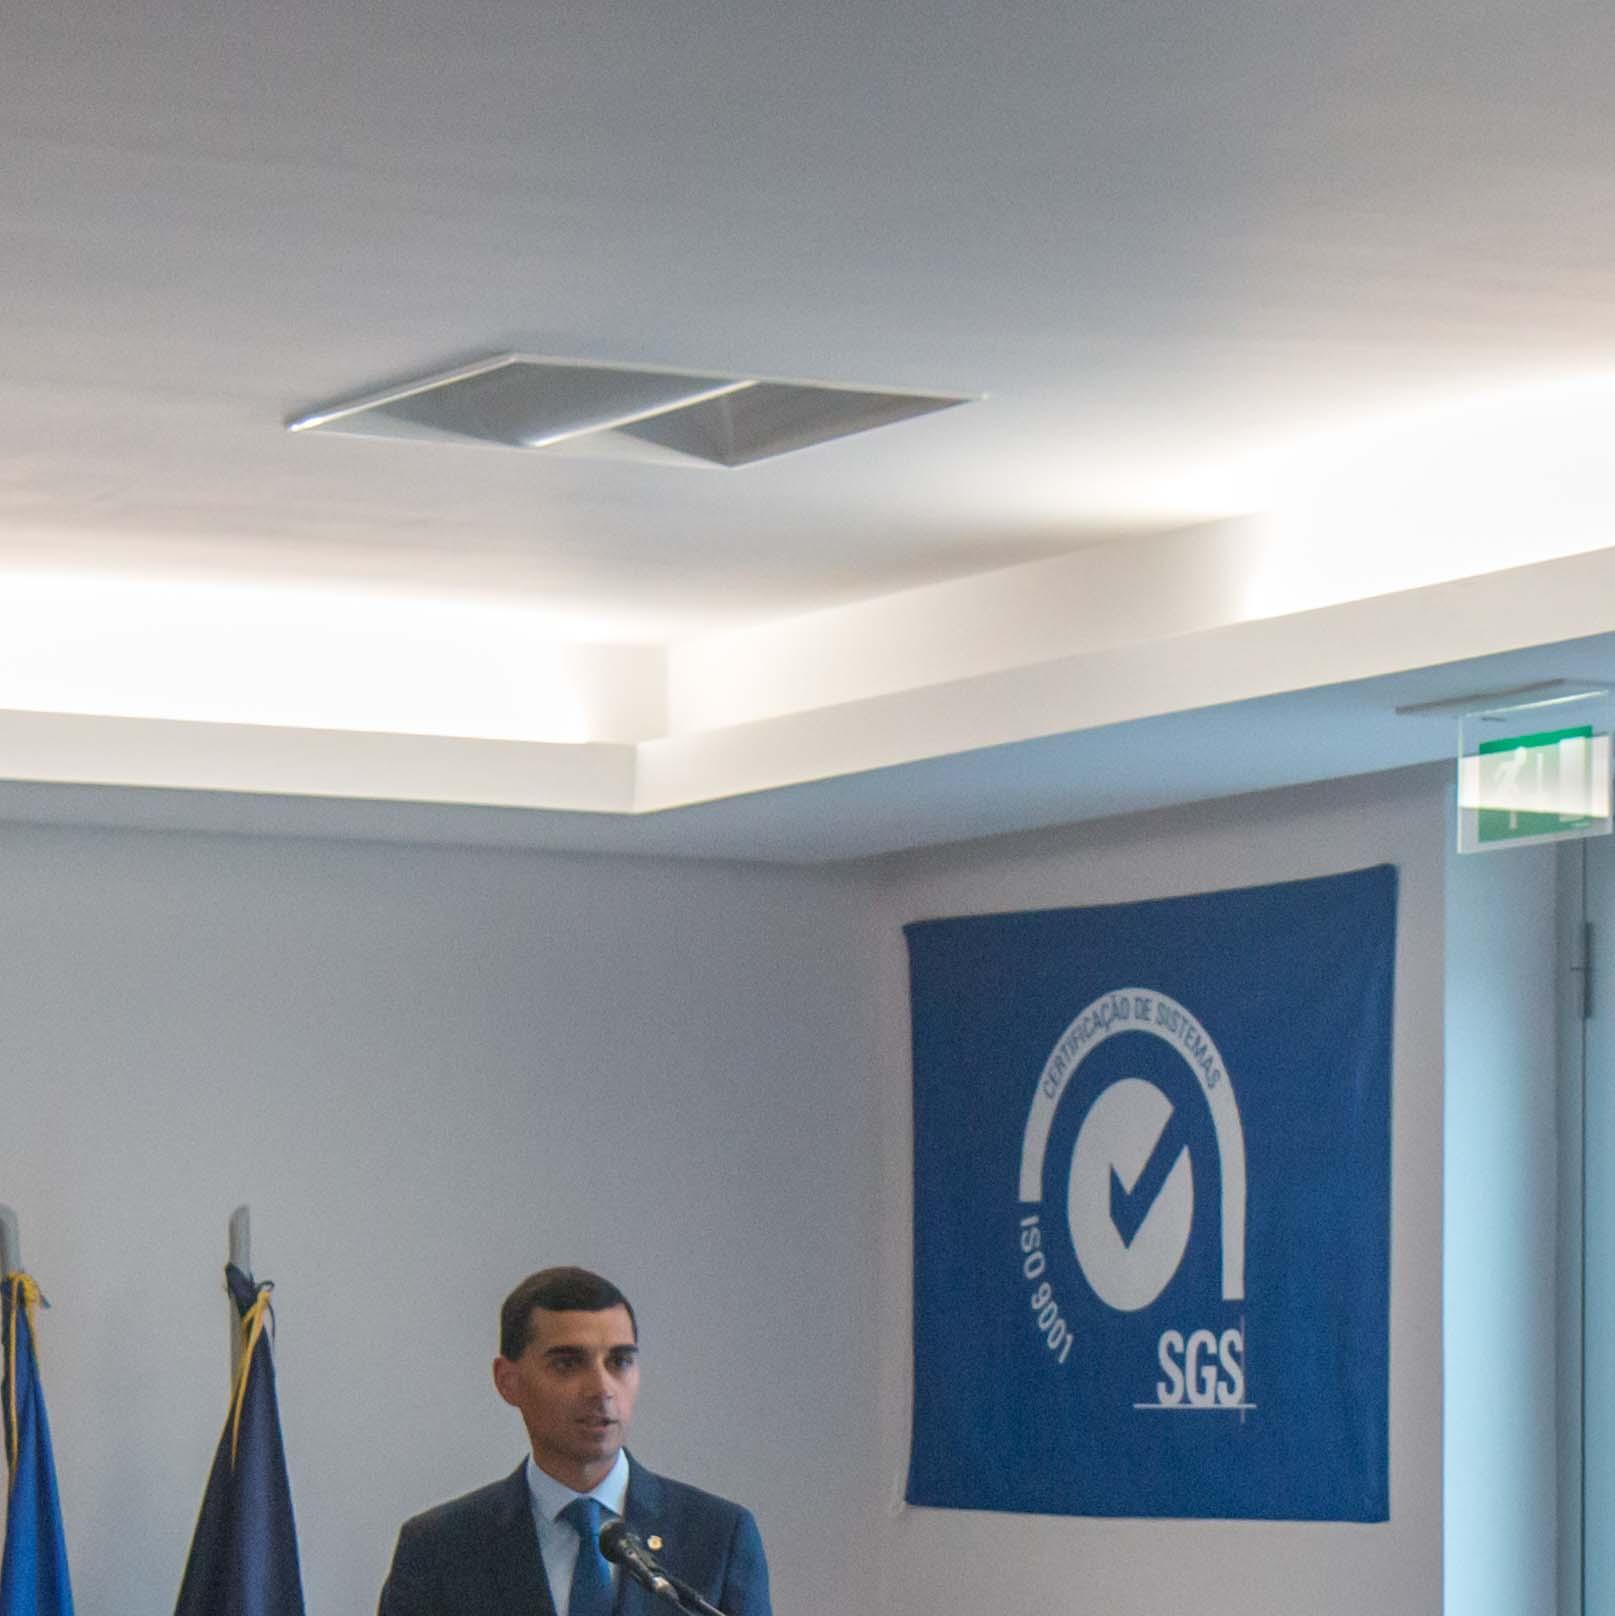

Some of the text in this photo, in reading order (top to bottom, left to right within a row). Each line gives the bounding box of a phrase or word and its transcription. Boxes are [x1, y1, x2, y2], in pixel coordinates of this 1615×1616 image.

[1043, 995, 1221, 1099] CERTIFICAÇÃO DE SISTEMAS
[1020, 1215, 1074, 1364] ISO 9001
[1156, 1328, 1245, 1406] SGS
